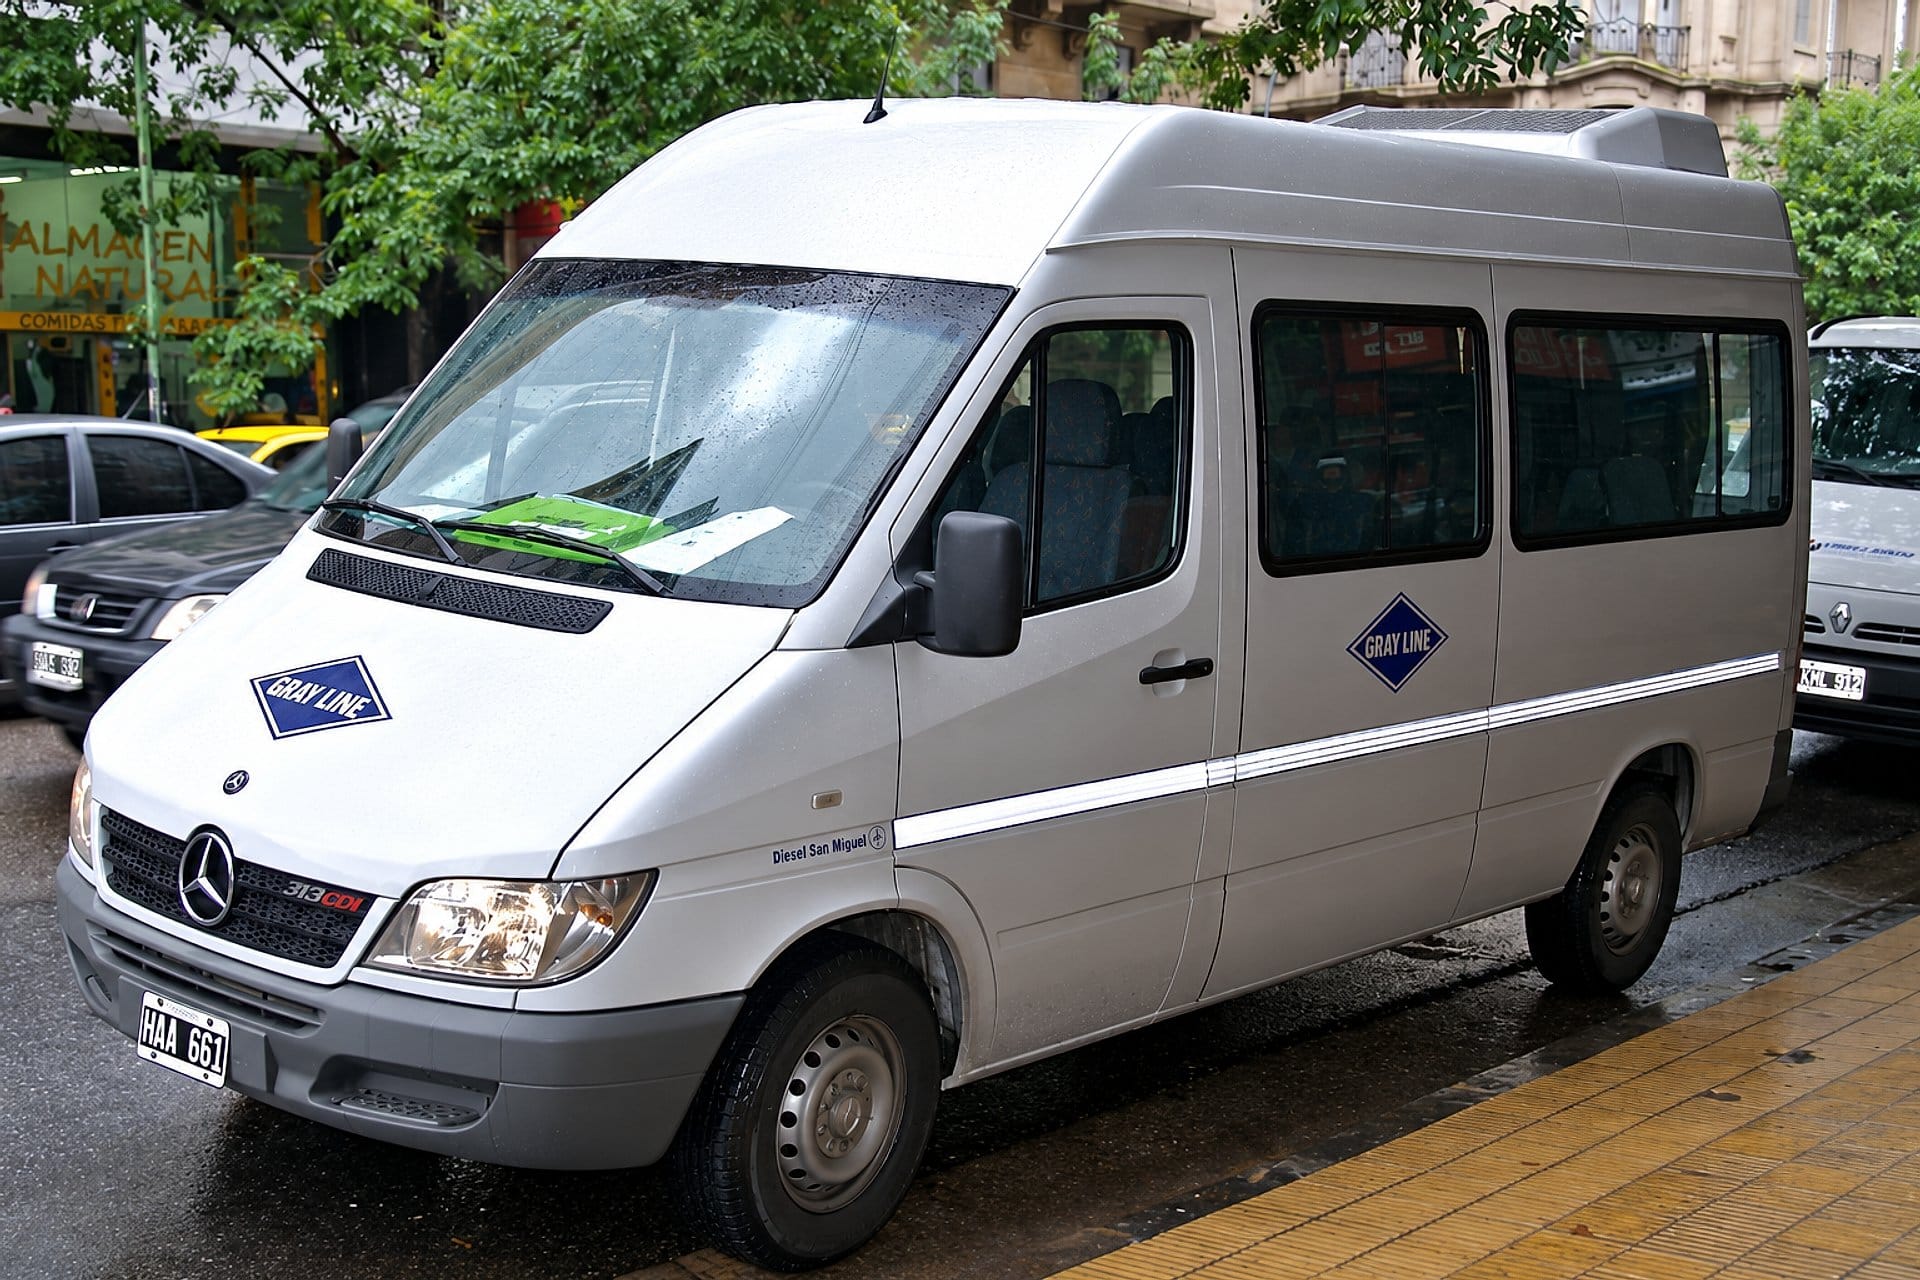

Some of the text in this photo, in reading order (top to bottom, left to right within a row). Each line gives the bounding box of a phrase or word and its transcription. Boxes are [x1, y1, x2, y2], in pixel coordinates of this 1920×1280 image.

[36, 263, 233, 302] NATURAL
[19, 313, 106, 331] COMIDAS
[1364, 628, 1432, 659] GRAY LINE
[266, 676, 372, 719] GRAY LINE
[1833, 673, 1863, 693] 912
[772, 834, 867, 865] Diesel San Miguel
[142, 1008, 178, 1055] HAA
[187, 1027, 223, 1074] 661
